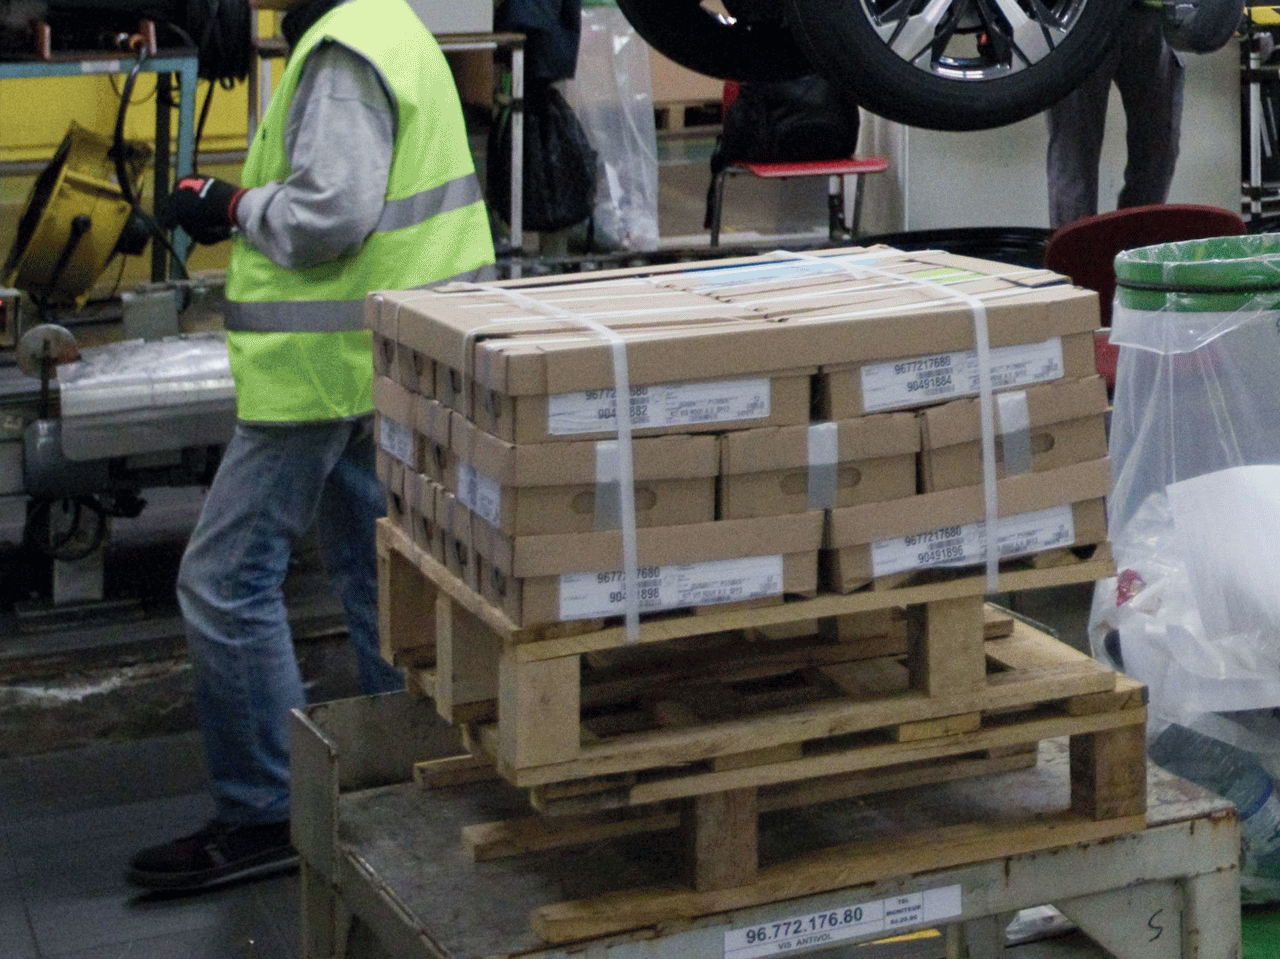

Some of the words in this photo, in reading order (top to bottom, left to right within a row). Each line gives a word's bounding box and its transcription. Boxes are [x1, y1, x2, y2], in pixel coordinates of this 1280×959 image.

[746, 906, 863, 944] 96.772.176.80
[778, 941, 792, 950] VIS
[796, 932, 832, 948] ANTIVOL
